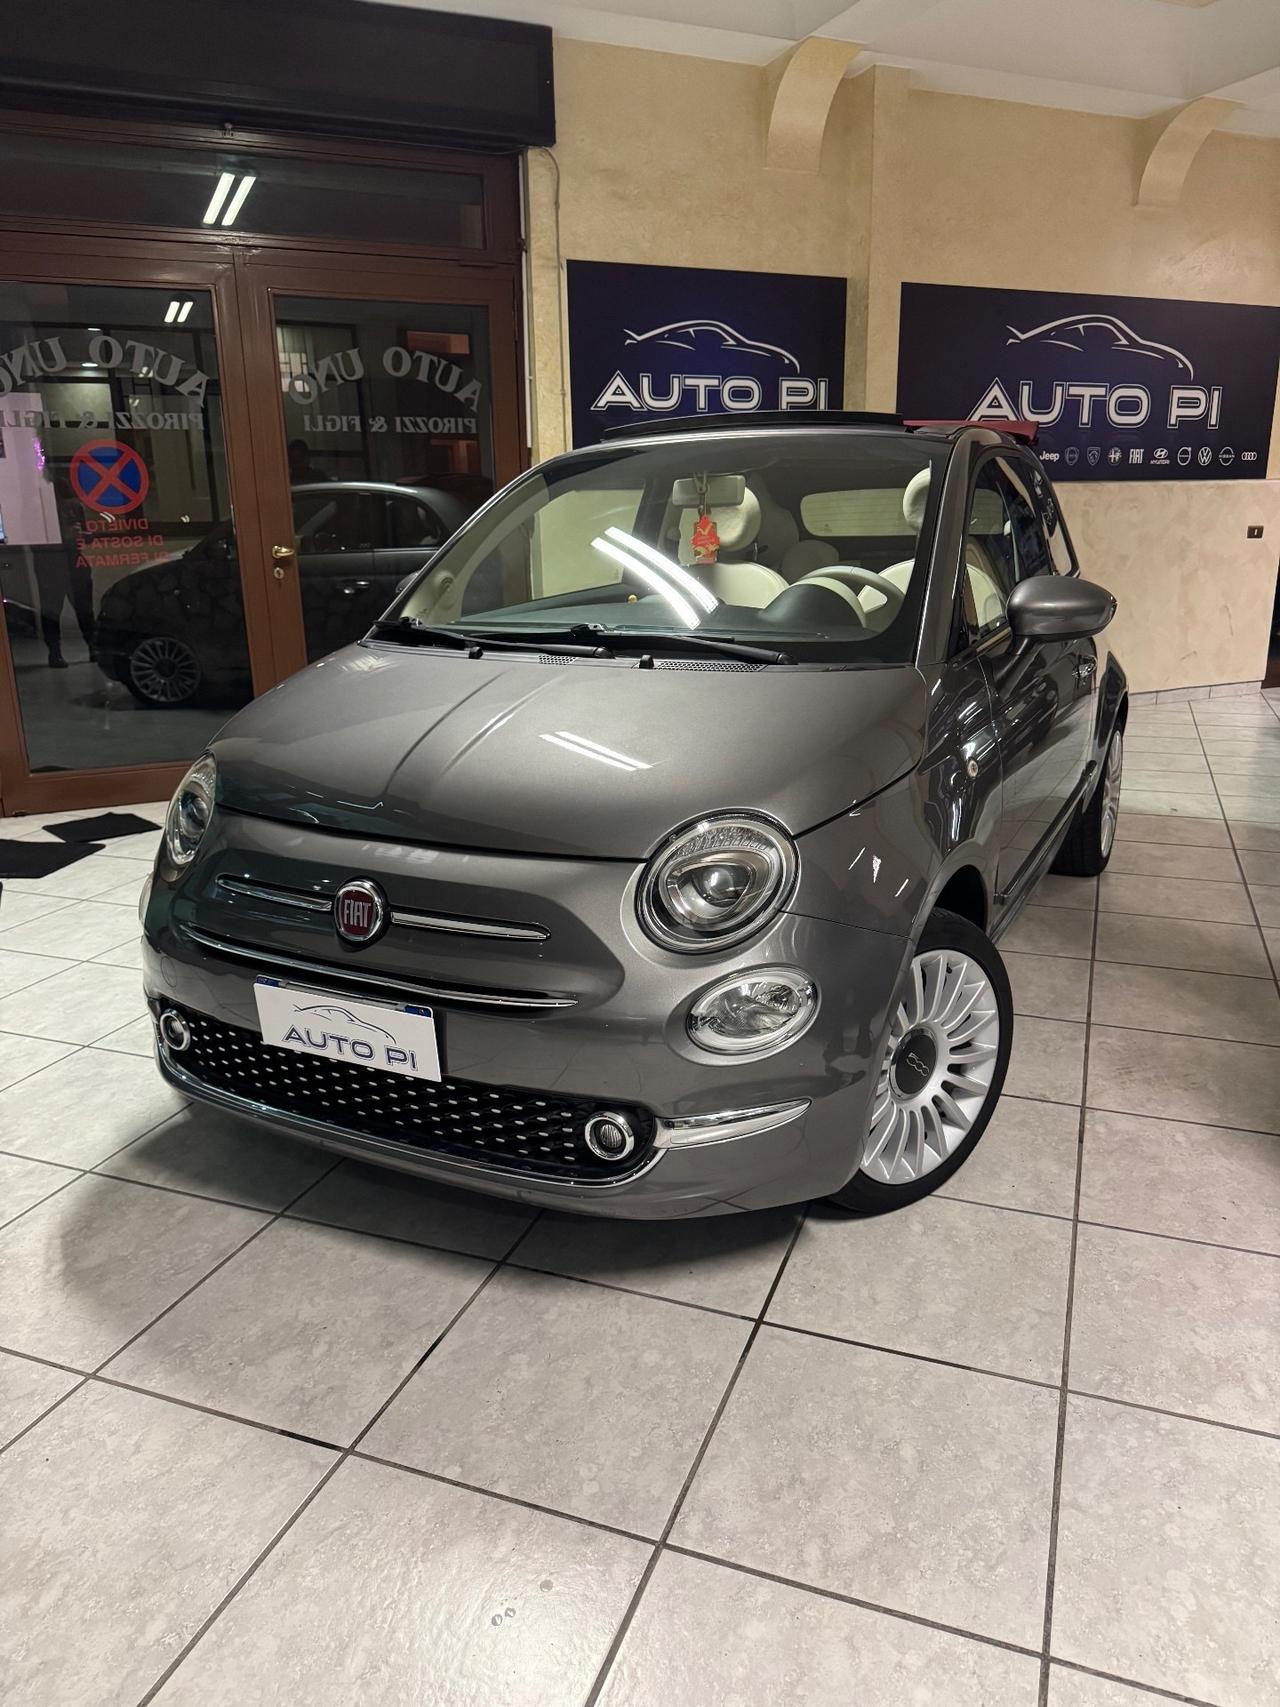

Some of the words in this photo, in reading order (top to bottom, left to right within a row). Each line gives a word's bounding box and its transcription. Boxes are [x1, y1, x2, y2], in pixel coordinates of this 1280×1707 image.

[590, 370, 763, 412] AUTO
[778, 376, 828, 411] PI
[964, 377, 1151, 429] AUTO
[1167, 385, 1222, 430] PI
[1039, 450, 1060, 463] Jeep
[1128, 448, 1145, 465] FIAT
[343, 899, 371, 928] FIAT
[282, 1024, 375, 1060] AUTO
[384, 1044, 418, 1071] PI
